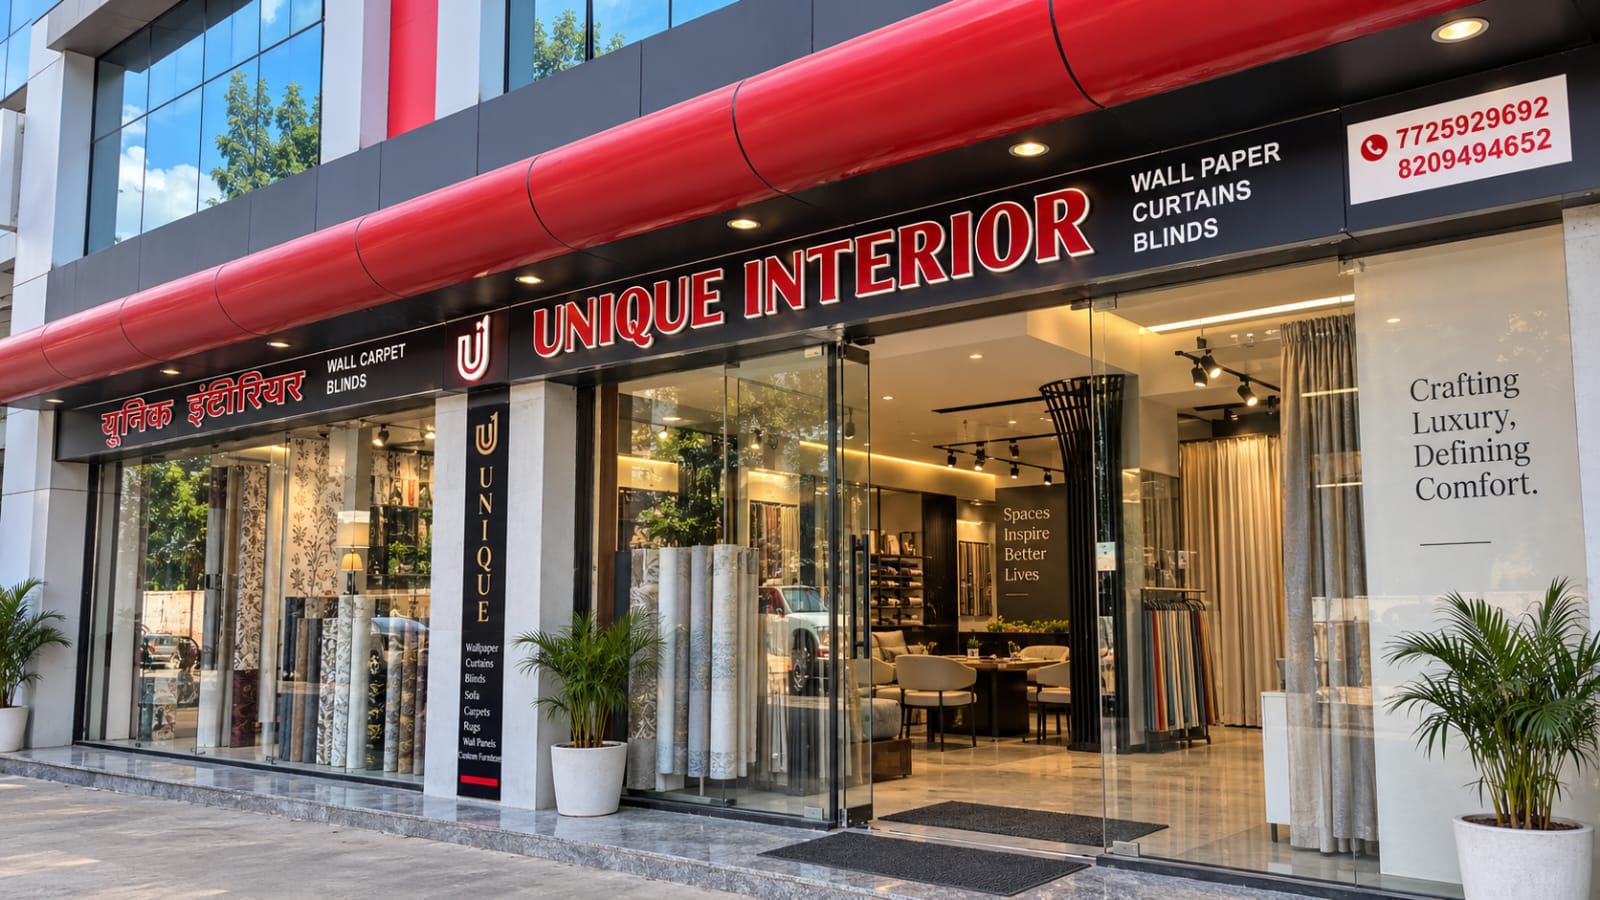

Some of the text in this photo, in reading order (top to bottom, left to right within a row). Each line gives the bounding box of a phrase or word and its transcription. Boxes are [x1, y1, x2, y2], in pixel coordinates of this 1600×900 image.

[1396, 95, 1550, 149] 7725929692
[1130, 141, 1281, 193] WALL PAPER
[1397, 126, 1553, 180] 8209494652
[1131, 179, 1252, 223] CURTAINS
[1133, 217, 1219, 253] BLINDS
[532, 187, 1096, 359] UNIQUE INTERIOR
[326, 342, 406, 374] WALL CARPET
[186, 370, 306, 428] इंटीरियर
[326, 374, 367, 395] BLINDS
[1410, 371, 1520, 402] Crafting
[1413, 407, 1517, 436] Luxury,
[1415, 438, 1531, 468] Defining
[1415, 471, 1538, 501] Comfort.
[1003, 506, 1051, 525] Spaces
[476, 466, 494, 623] UNIQUE
[1004, 526, 1050, 545] Inspire
[1004, 547, 1047, 562] Better
[1005, 567, 1040, 582] Lives
[465, 642, 499, 655] Wallpaper
[465, 658, 494, 669] Curtains
[464, 673, 487, 684] Blinds
[464, 690, 480, 701] Sofa
[463, 706, 491, 719] Carpets
[463, 721, 481, 734] Rugs
[462, 736, 497, 749] Wall Panels
